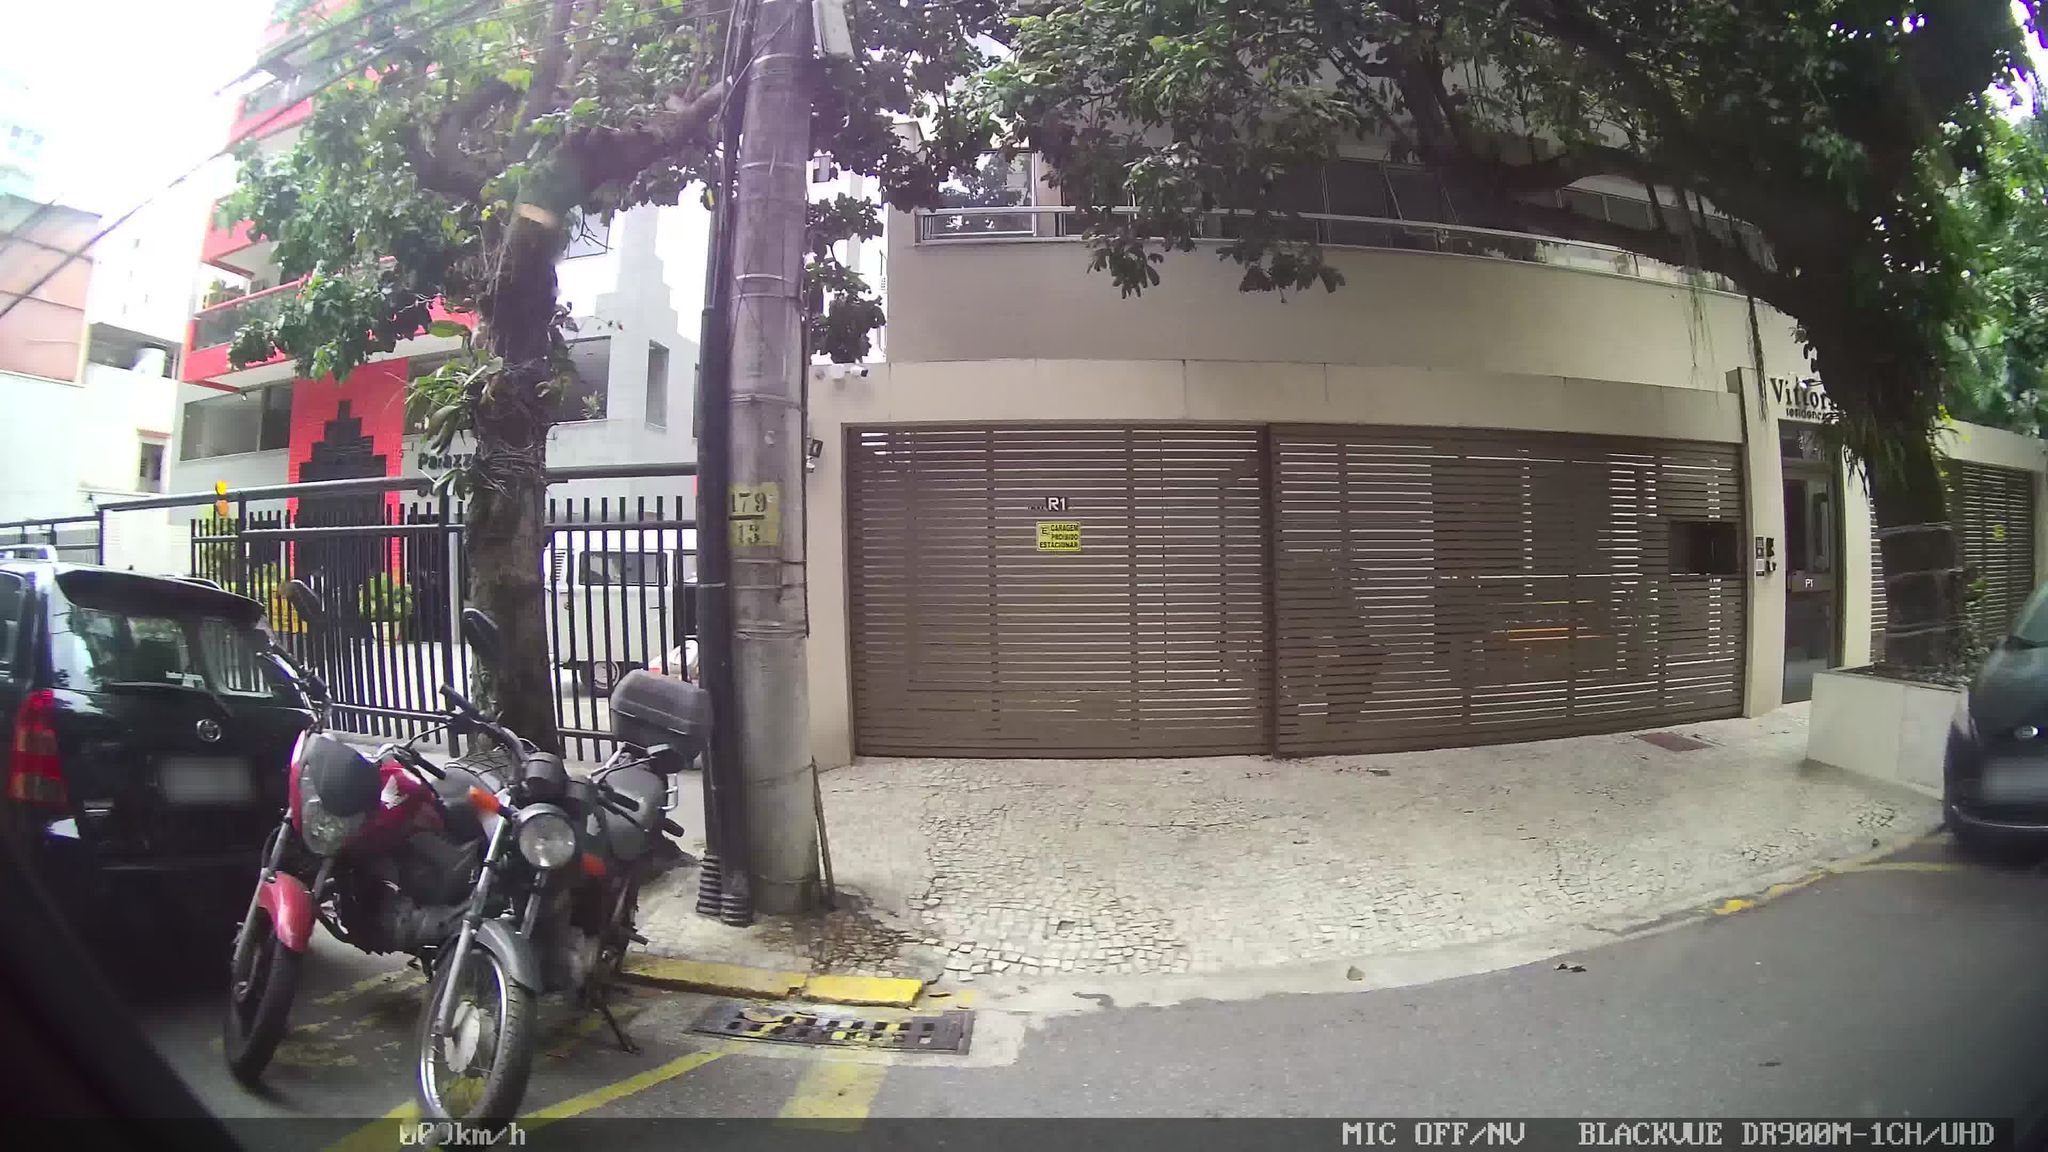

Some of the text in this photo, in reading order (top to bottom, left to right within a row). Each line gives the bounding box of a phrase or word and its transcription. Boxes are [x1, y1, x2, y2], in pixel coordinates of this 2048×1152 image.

[1770, 376, 1834, 410] Vittor
[1785, 407, 1827, 421] residenc
[418, 452, 476, 470] Palazz
[731, 492, 767, 513] 179
[1047, 497, 1067, 511] R1
[1039, 541, 1079, 549] ESTACIONAR
